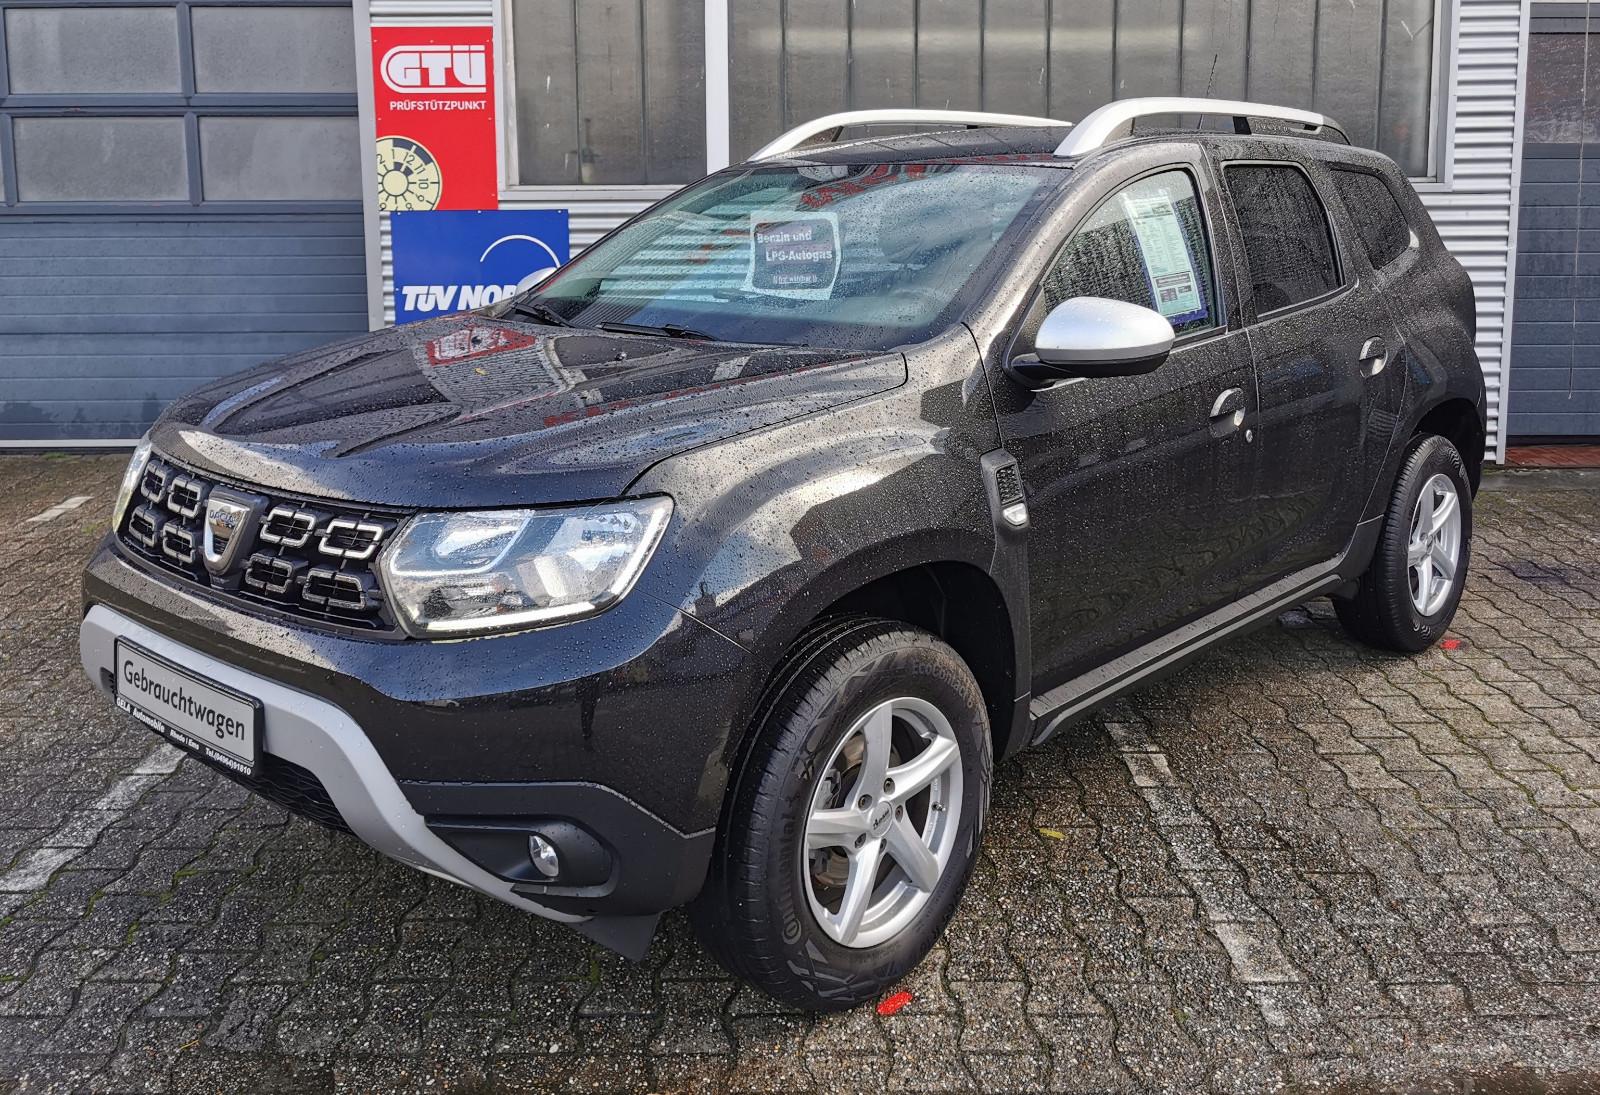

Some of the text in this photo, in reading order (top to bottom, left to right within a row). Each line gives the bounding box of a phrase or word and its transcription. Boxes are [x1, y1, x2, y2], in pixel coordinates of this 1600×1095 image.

[385, 45, 487, 88] GTÜ
[389, 99, 487, 111] PRÜFSTÜTZPUNKT
[403, 152, 415, 165] 12
[414, 163, 426, 175] 11
[418, 178, 429, 189] 10
[756, 229, 812, 243] Benzin und
[765, 250, 833, 262] LPG-Autogas
[402, 285, 458, 312] TÜV
[123, 660, 245, 741] Gebrauchtwagen
[116, 697, 131, 713] GELA
[132, 707, 165, 733] Automobile
